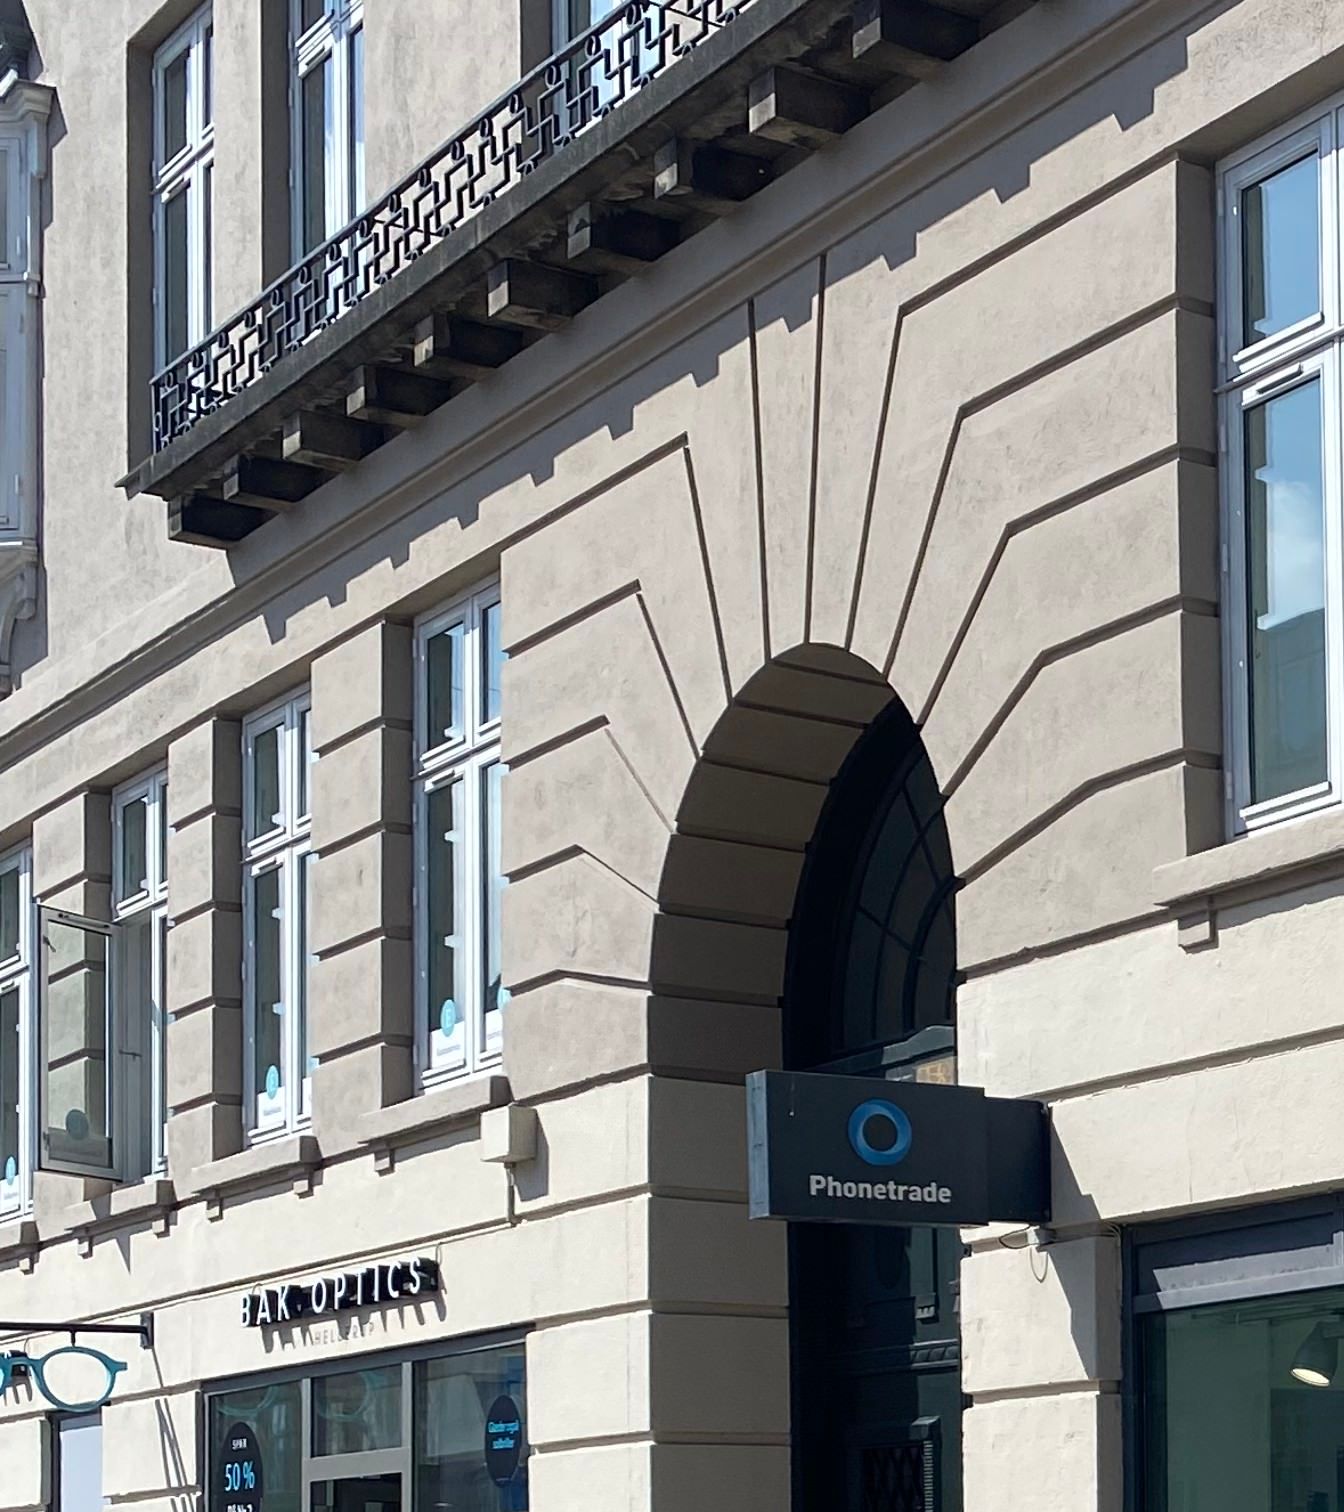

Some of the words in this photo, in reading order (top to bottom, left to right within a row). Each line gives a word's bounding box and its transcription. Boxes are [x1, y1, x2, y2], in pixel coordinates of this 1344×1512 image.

[809, 1175, 952, 1204] Phonetrade
[240, 1286, 290, 1328] BAK
[311, 1257, 421, 1314] OPTICS
[225, 1463, 241, 1492] 50
[242, 1460, 256, 1490] %
